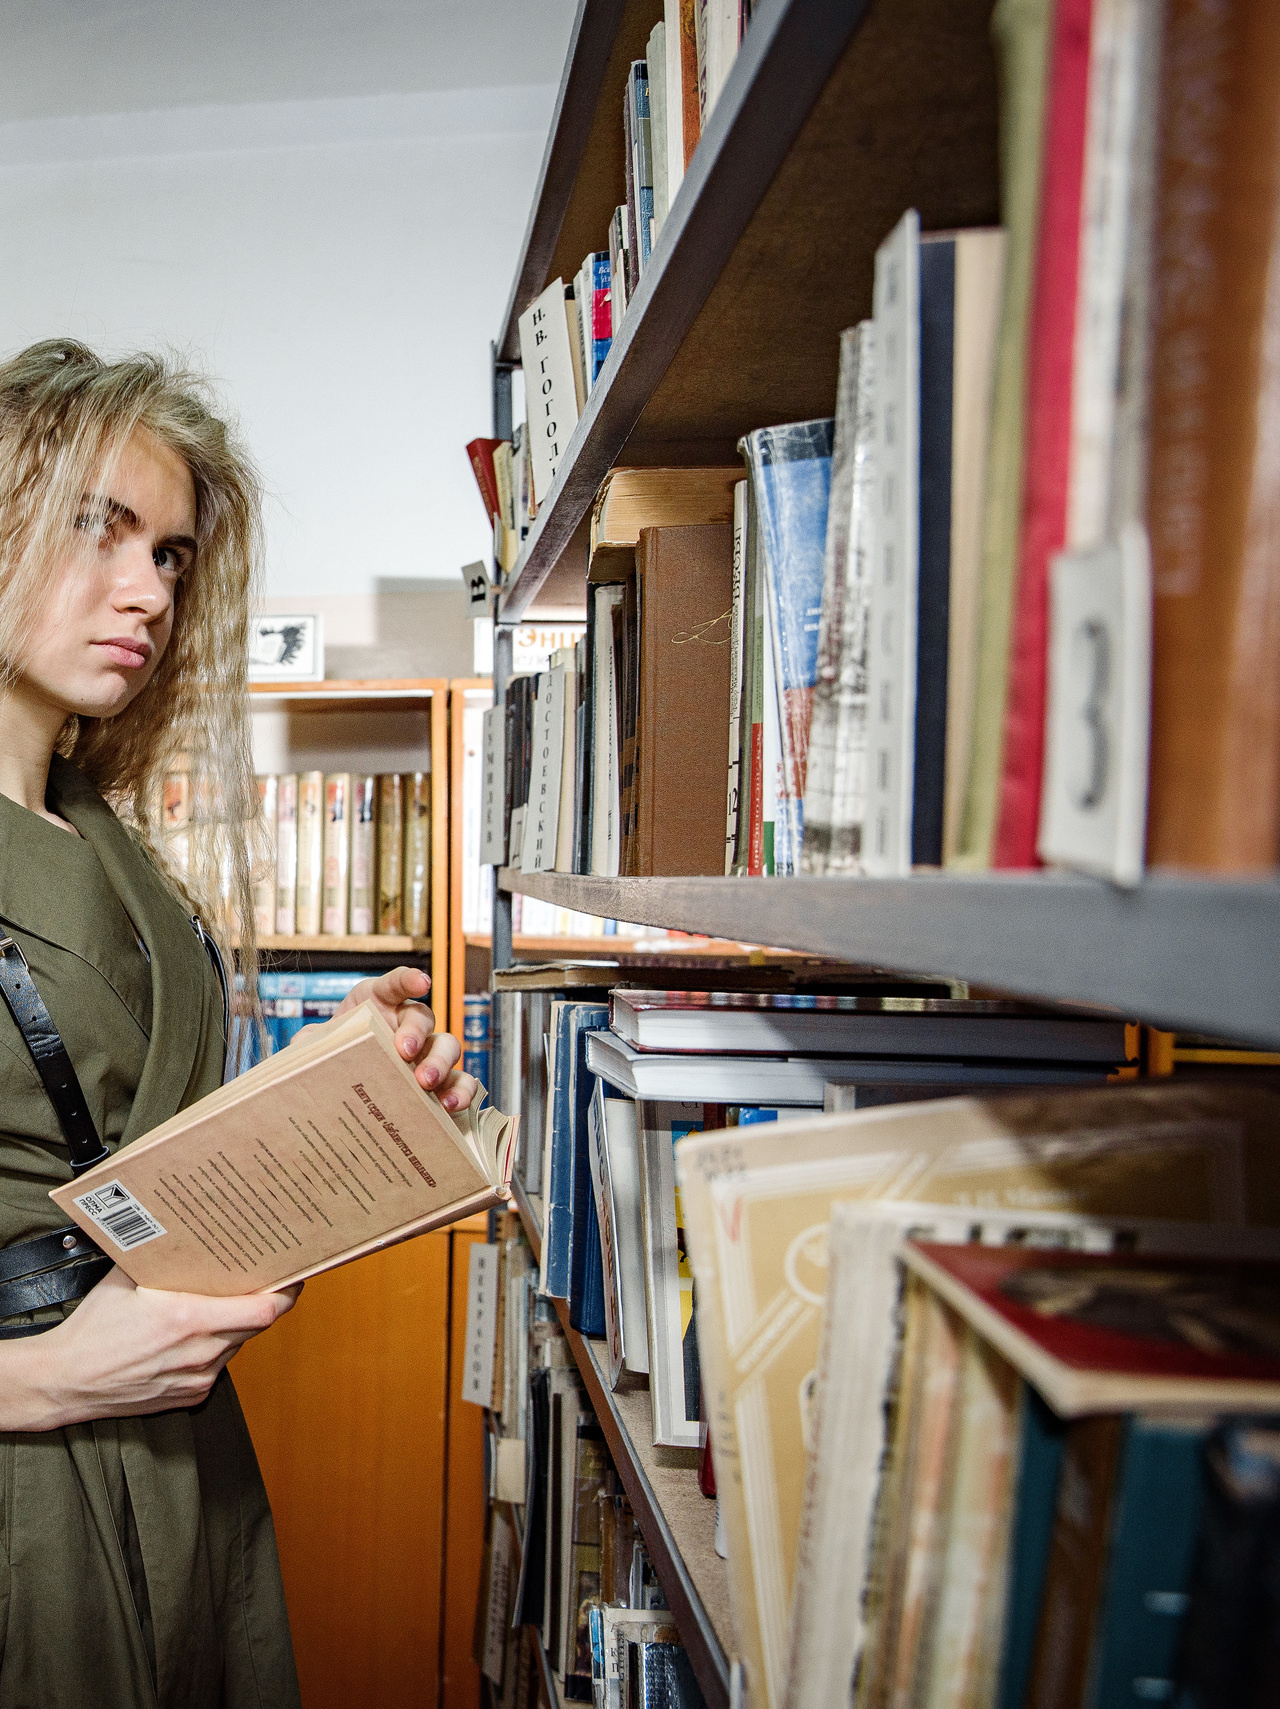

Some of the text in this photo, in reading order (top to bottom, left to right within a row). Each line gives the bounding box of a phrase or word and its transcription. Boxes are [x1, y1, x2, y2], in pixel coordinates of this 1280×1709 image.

[531, 308, 546, 328] Н.
[534, 330, 548, 348] В.
[532, 674, 556, 869] ДОСТОЕВСКИЙ
[350, 1081, 373, 1105] Книги
[364, 1100, 386, 1124] серии
[380, 1118, 414, 1157] «Библиотека
[77, 1198, 98, 1216] ПРЕСС
[84, 1195, 103, 1213] ОЛМА
